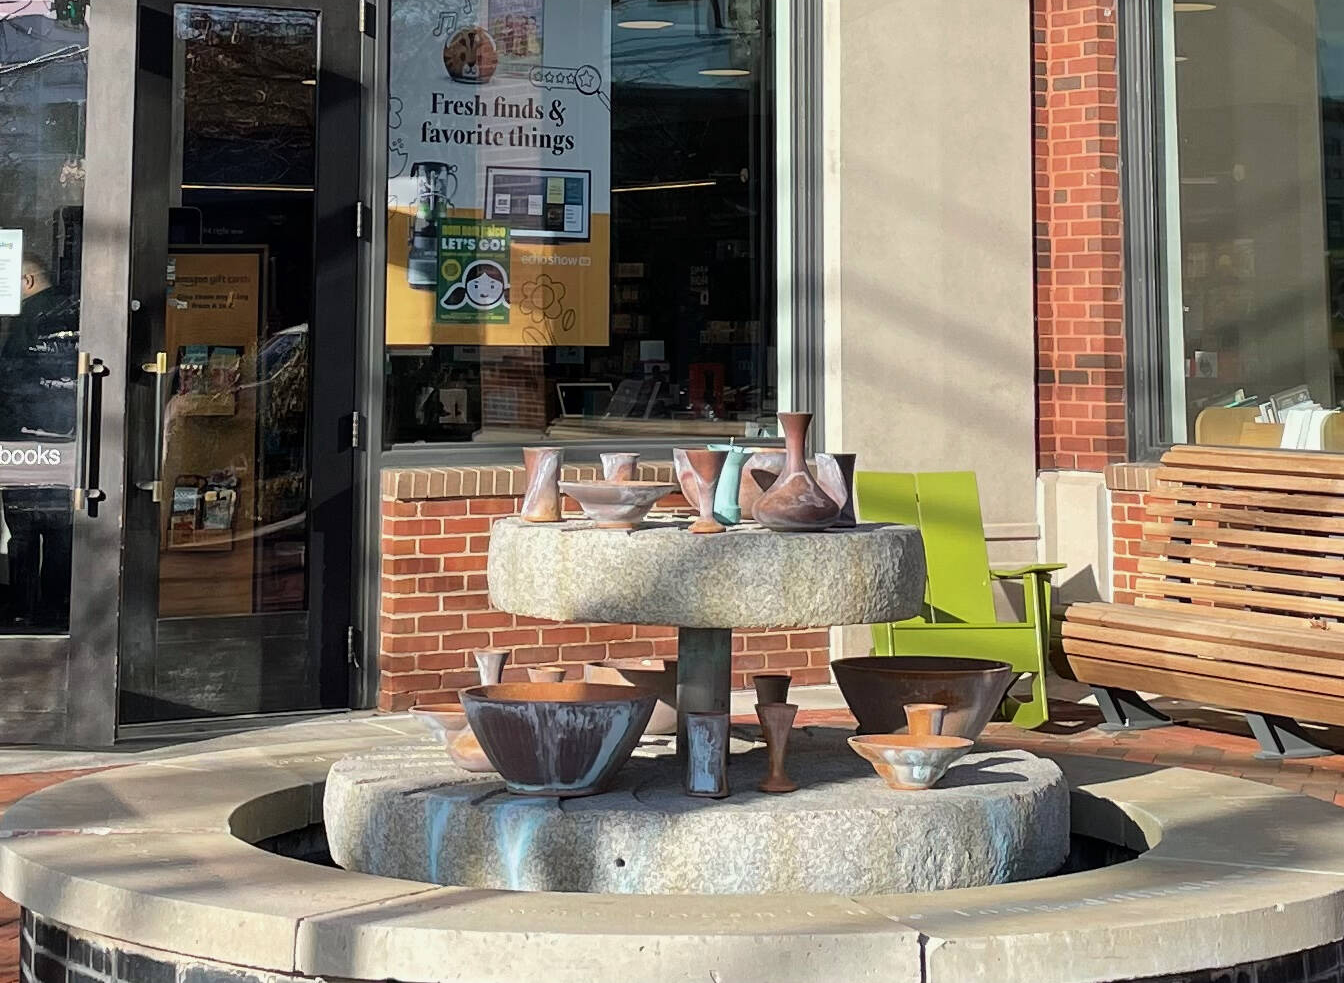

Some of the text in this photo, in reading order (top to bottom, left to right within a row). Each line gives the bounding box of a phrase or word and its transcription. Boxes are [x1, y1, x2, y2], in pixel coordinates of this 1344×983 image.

[431, 92, 566, 127] Fresh finds &
[420, 121, 575, 155] favorite things
[441, 237, 506, 252] LET'S GO!
[548, 254, 577, 266] show
